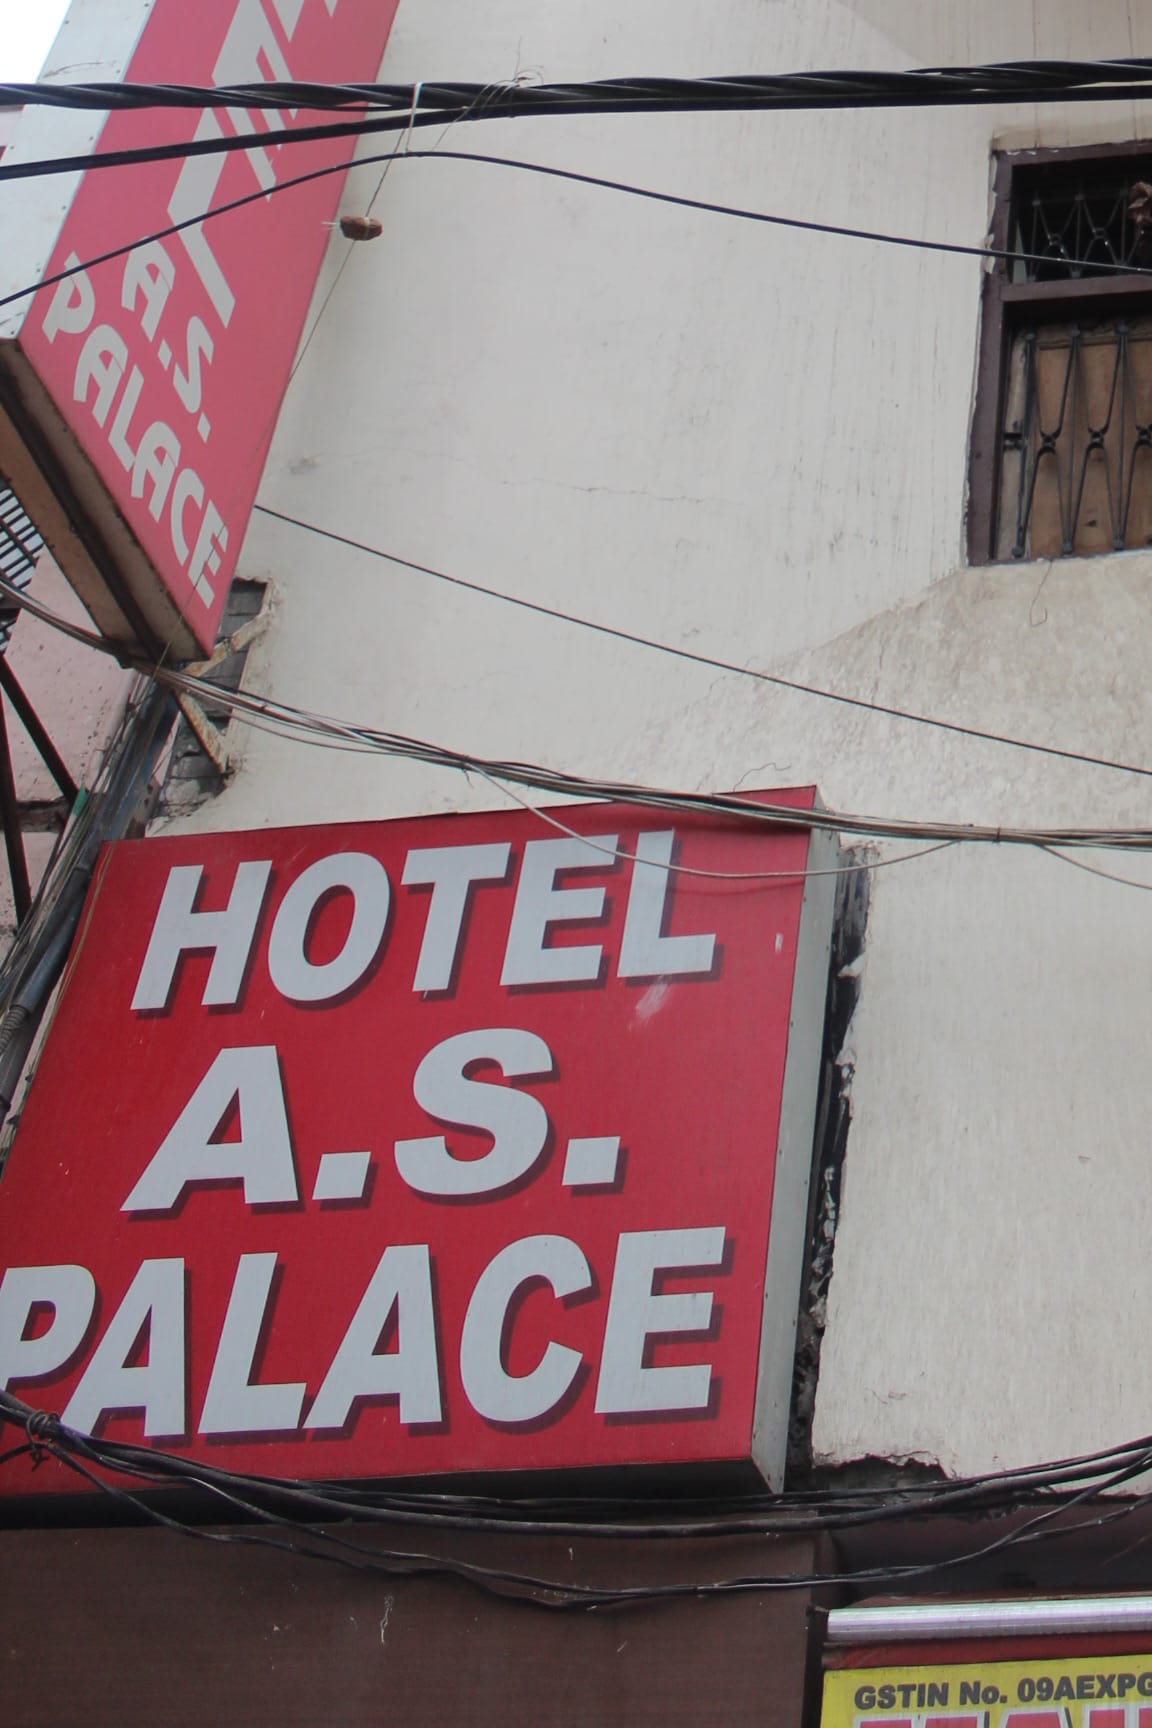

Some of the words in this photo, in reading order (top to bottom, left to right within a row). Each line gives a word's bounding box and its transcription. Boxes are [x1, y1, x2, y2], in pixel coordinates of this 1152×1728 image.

[42, 250, 229, 610] PALACE
[121, 235, 215, 444] A.S.
[131, 829, 720, 1012] HOTEL
[120, 1027, 622, 1213] A.S.
[0, 1226, 727, 1438] PALACE
[854, 1681, 949, 1710] GSTIN
[959, 1680, 1008, 1705] No.
